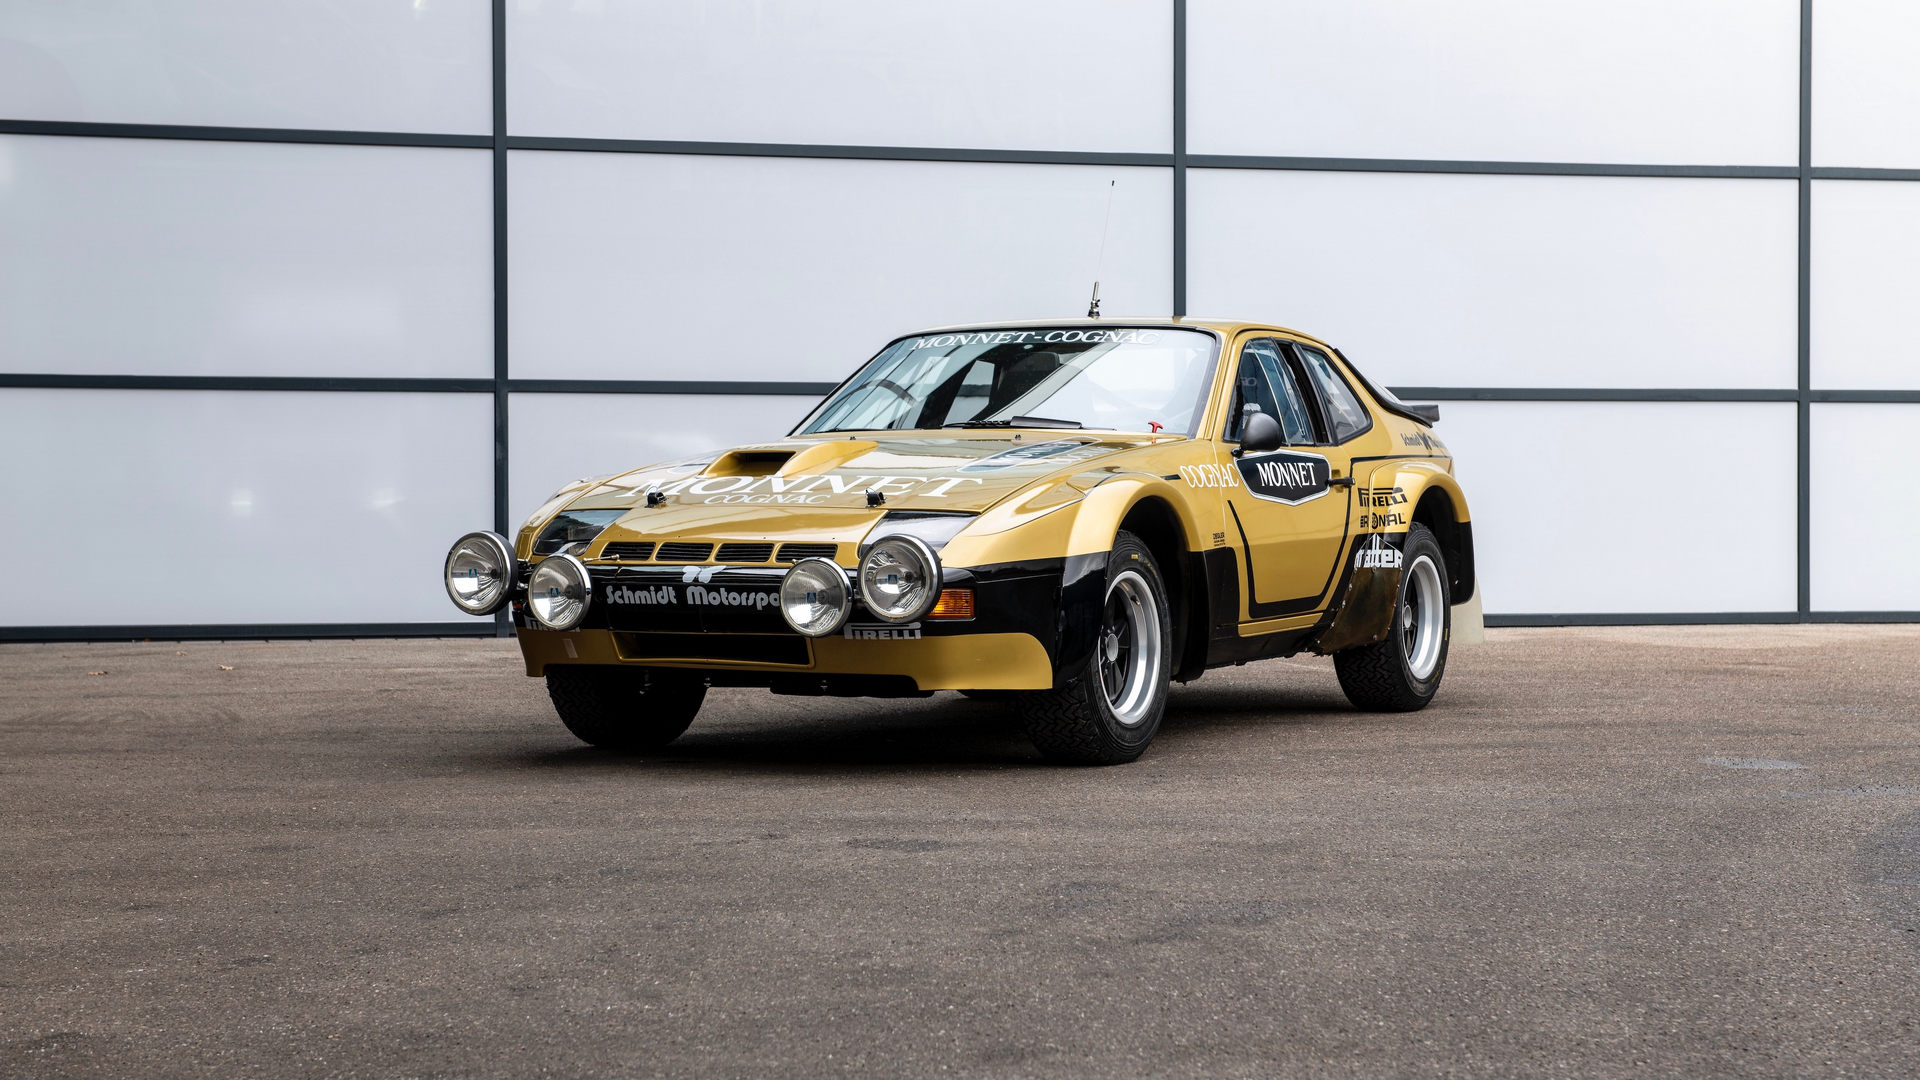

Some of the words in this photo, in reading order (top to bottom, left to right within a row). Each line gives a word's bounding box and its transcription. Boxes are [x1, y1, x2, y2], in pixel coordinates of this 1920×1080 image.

[911, 330, 1158, 350] MONNET-COGNAC
[1180, 463, 1239, 488] COGNAC
[1256, 461, 1317, 489] MONNET
[615, 474, 982, 498] MONNET
[704, 494, 831, 504] COGNAC
[1357, 487, 1408, 508] PIRELLI
[606, 585, 677, 604] Schmidt
[686, 586, 781, 610] Motorspo
[843, 622, 921, 640] PIRELLI
